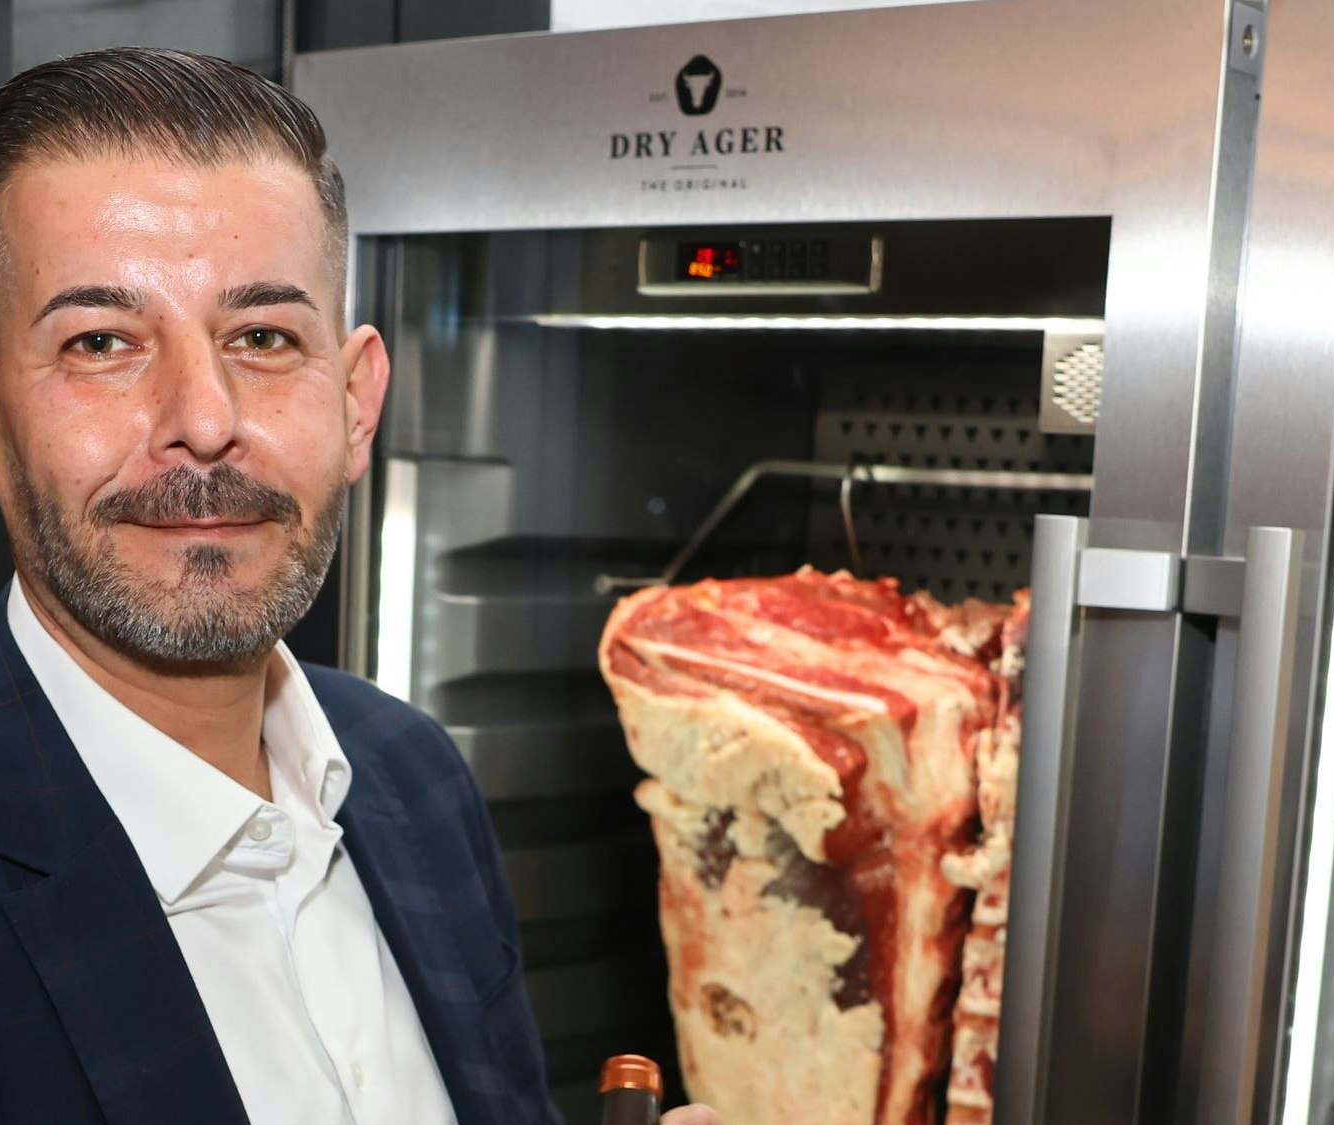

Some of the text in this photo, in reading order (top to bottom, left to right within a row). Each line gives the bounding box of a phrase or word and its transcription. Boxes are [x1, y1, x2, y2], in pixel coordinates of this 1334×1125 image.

[610, 126, 786, 160] DRY AGER
[641, 178, 748, 192] THE ORIGINAL
